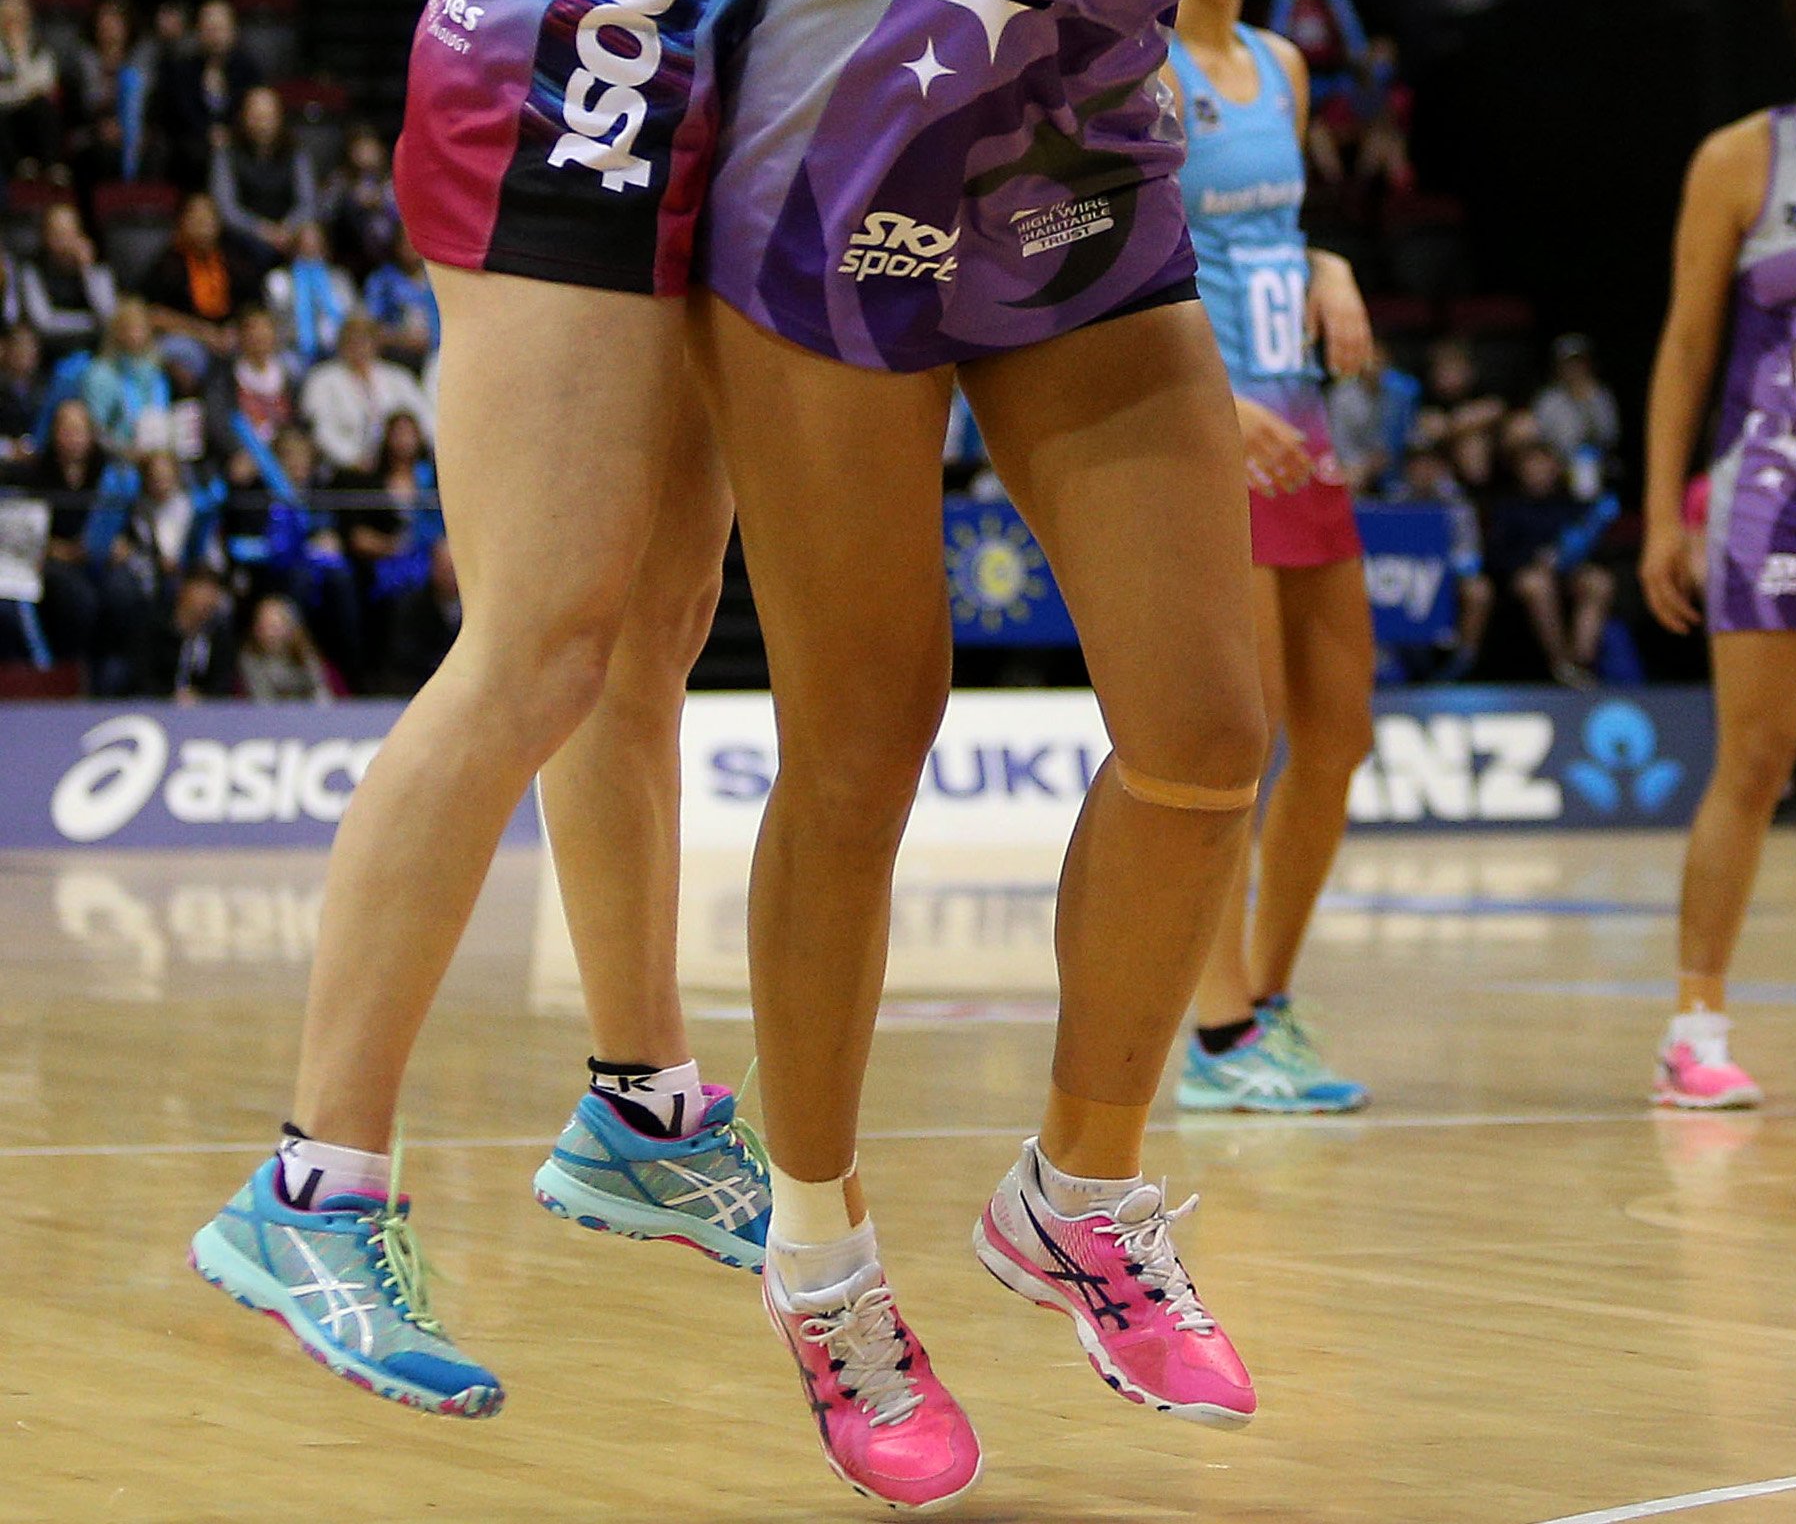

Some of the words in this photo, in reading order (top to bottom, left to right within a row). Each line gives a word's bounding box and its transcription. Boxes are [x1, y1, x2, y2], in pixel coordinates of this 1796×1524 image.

[1017, 210, 1055, 235] HIGH
[1058, 197, 1110, 219] WIRE
[1040, 226, 1091, 249] TRUST
[838, 249, 959, 282] sport
[165, 738, 386, 823] asic
[708, 742, 1092, 801] SUKI
